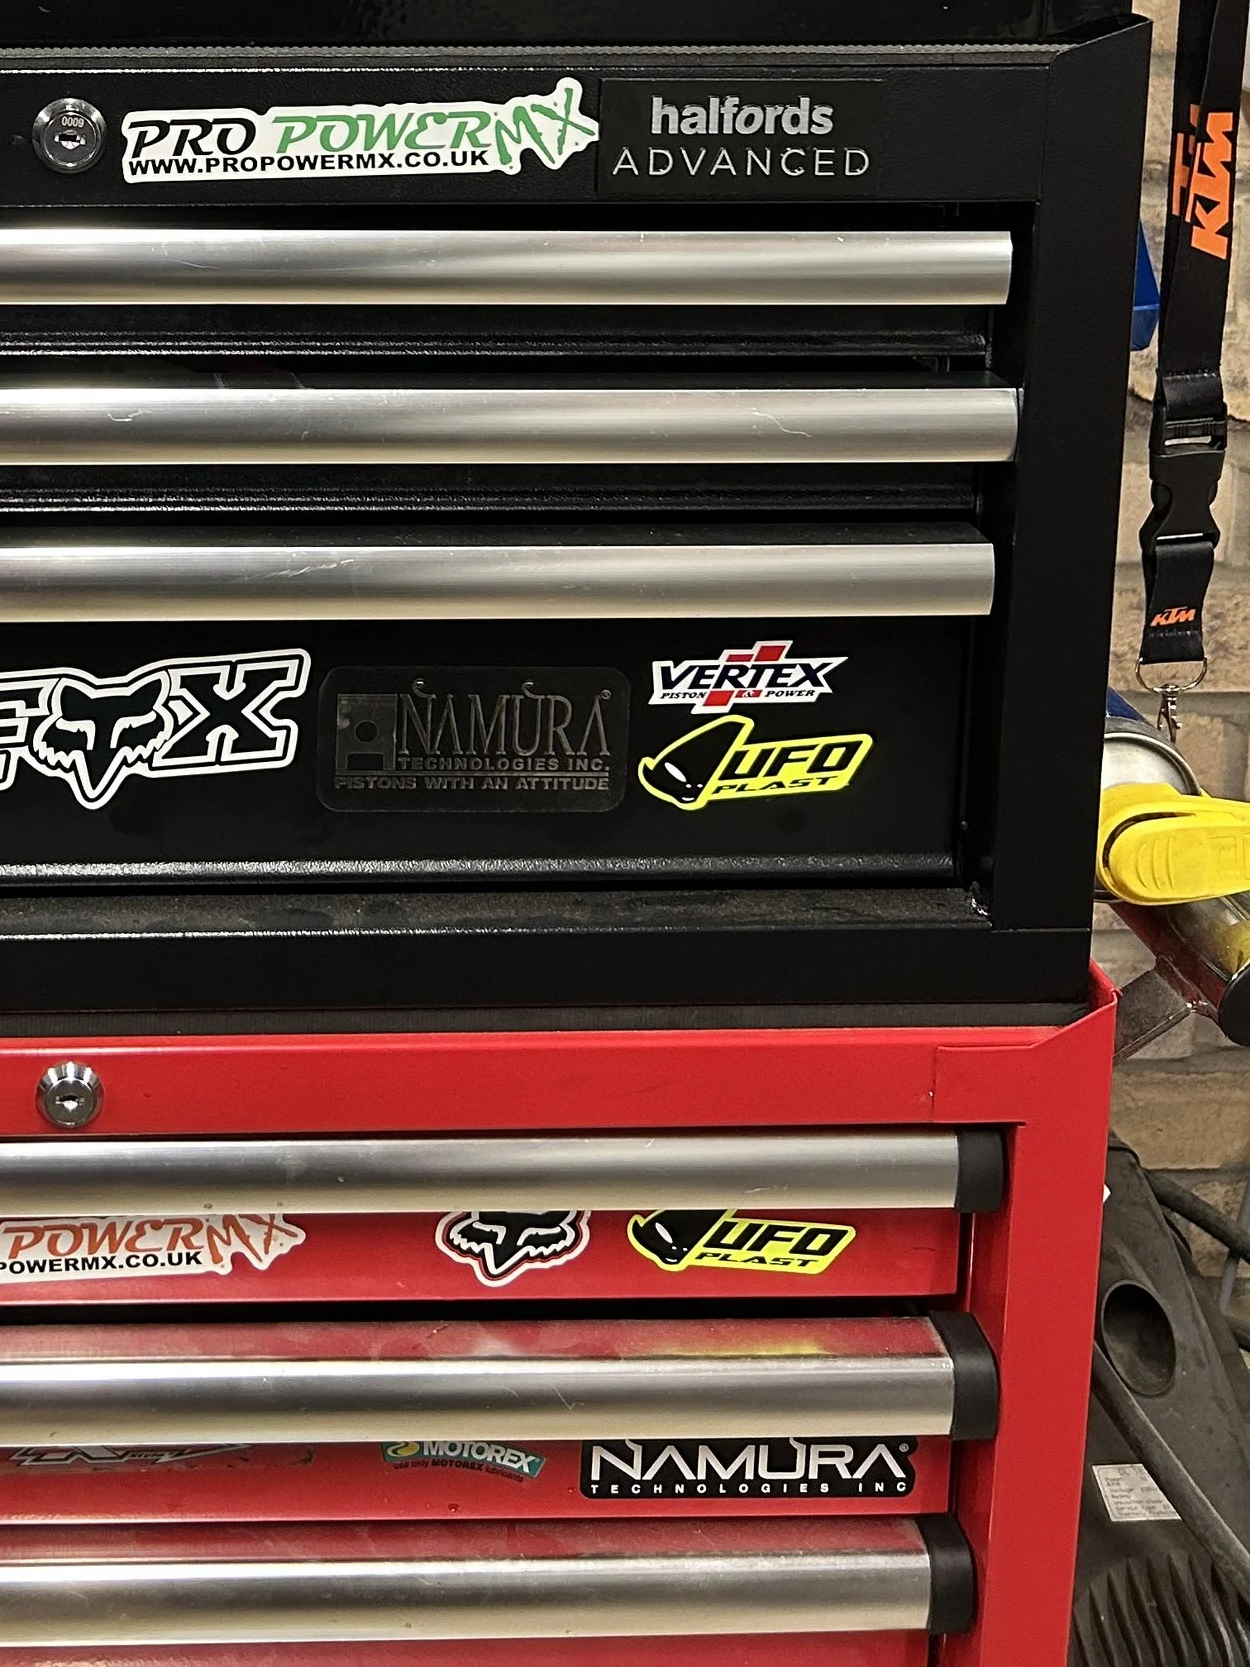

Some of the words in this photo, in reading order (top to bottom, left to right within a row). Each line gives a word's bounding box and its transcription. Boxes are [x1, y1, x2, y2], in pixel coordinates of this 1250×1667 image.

[651, 96, 834, 135] halfords
[127, 118, 258, 160] PRO
[128, 150, 490, 176] WWW.PROPOWERMX.CO.UK
[612, 146, 871, 177] ADVANCED
[1186, 112, 1233, 260] KTM
[1150, 606, 1196, 627] KTM
[660, 661, 834, 690] VERTEX
[660, 691, 707, 700] PISTON
[763, 689, 816, 699] POWER
[397, 677, 612, 757] NAMURA
[397, 757, 561, 772] TECHNOLOGIES
[567, 757, 611, 772] INC.
[716, 739, 865, 781] UFO
[333, 776, 418, 791] PISTONS
[423, 776, 474, 790] WITH
[481, 776, 508, 790] AN
[515, 776, 611, 791] ATTITUDE
[711, 775, 840, 795] PLAST
[701, 1219, 851, 1257] UFO
[694, 1250, 820, 1268] PLAST
[423, 1441, 537, 1474] MOTOREX
[590, 1437, 907, 1481] NAMURA
[589, 1482, 831, 1495] TECHNOLOGIES
[857, 1481, 908, 1493] INC
